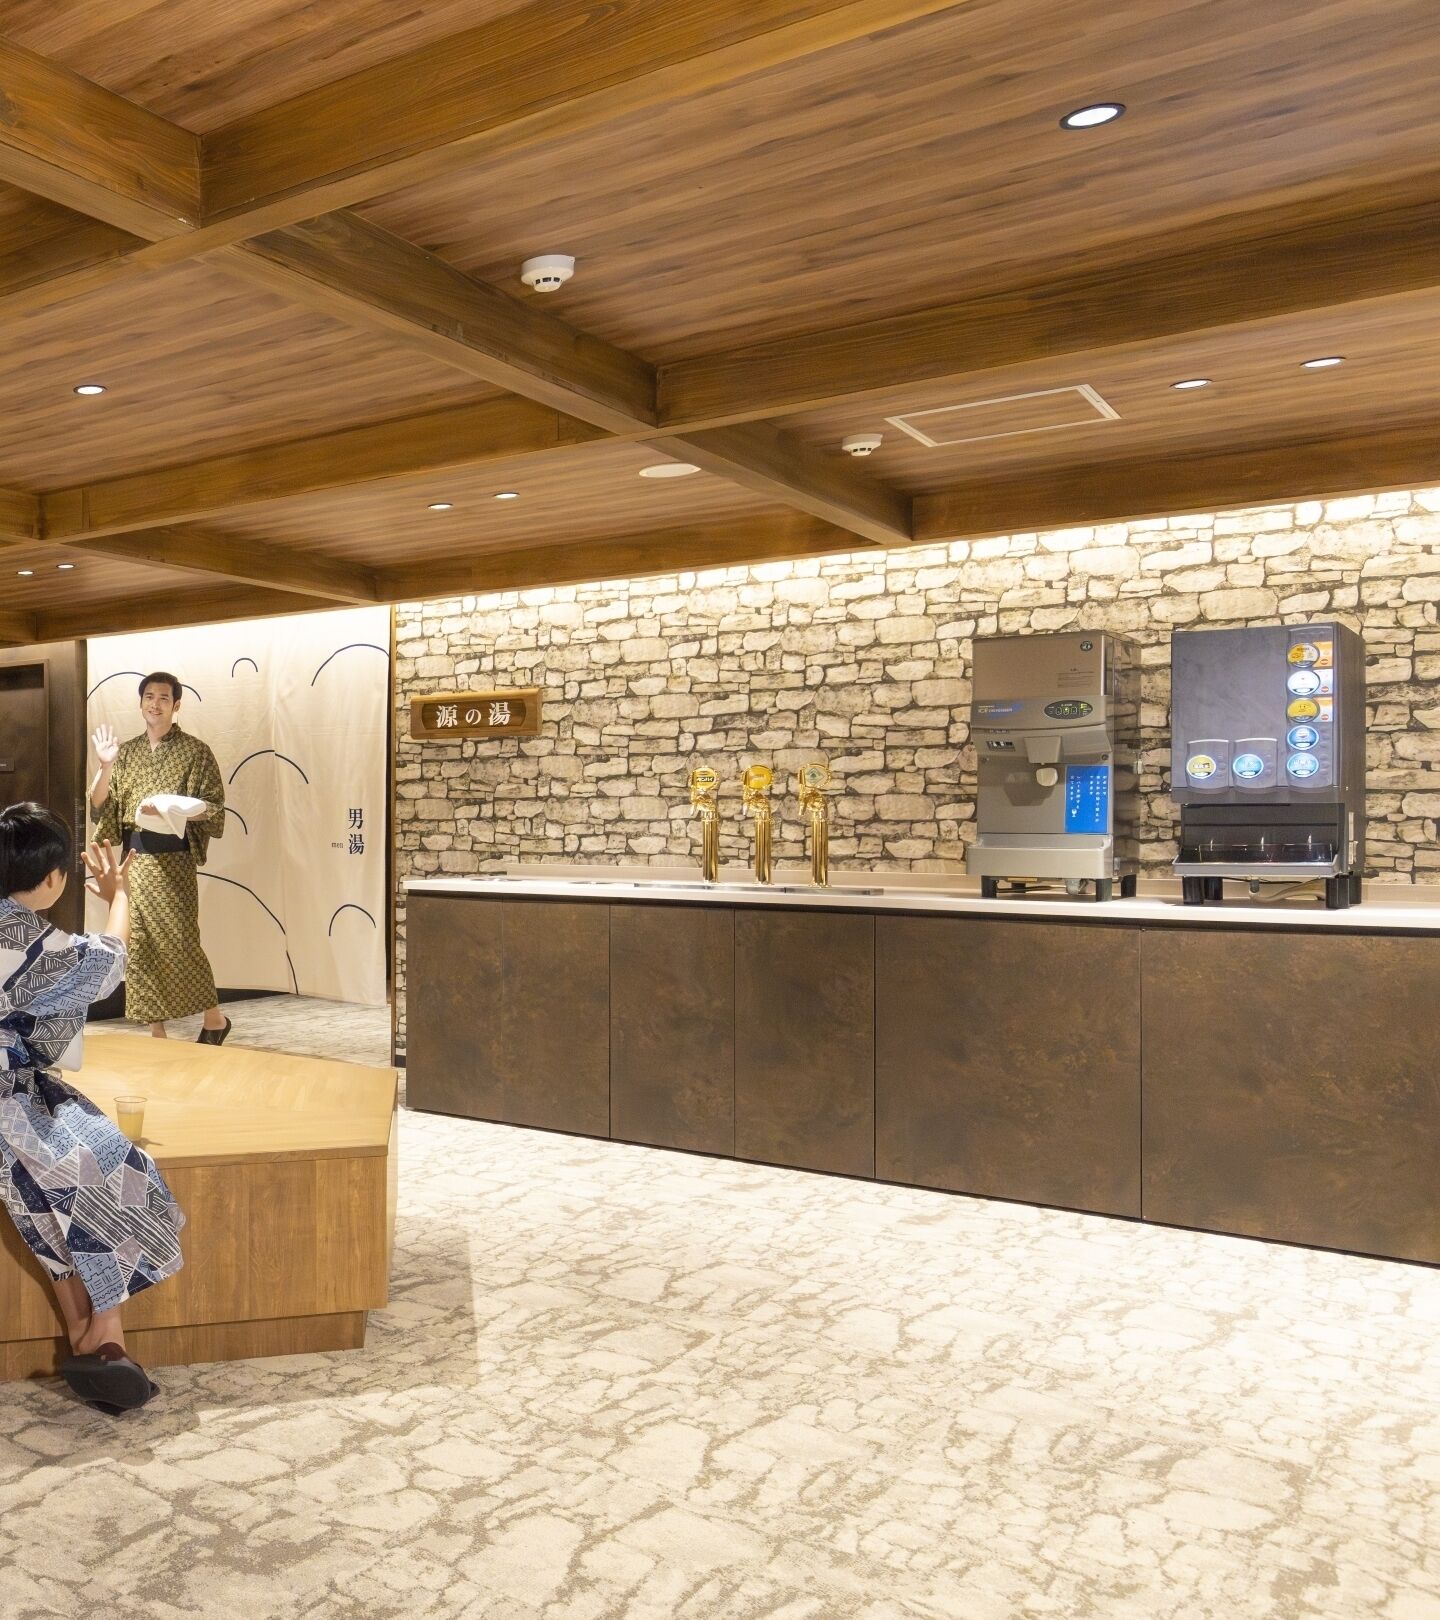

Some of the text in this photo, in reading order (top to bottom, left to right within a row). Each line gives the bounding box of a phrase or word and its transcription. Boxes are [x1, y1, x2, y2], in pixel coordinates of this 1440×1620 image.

[436, 702, 511, 728] 源の湯
[348, 807, 365, 855] 男湯
